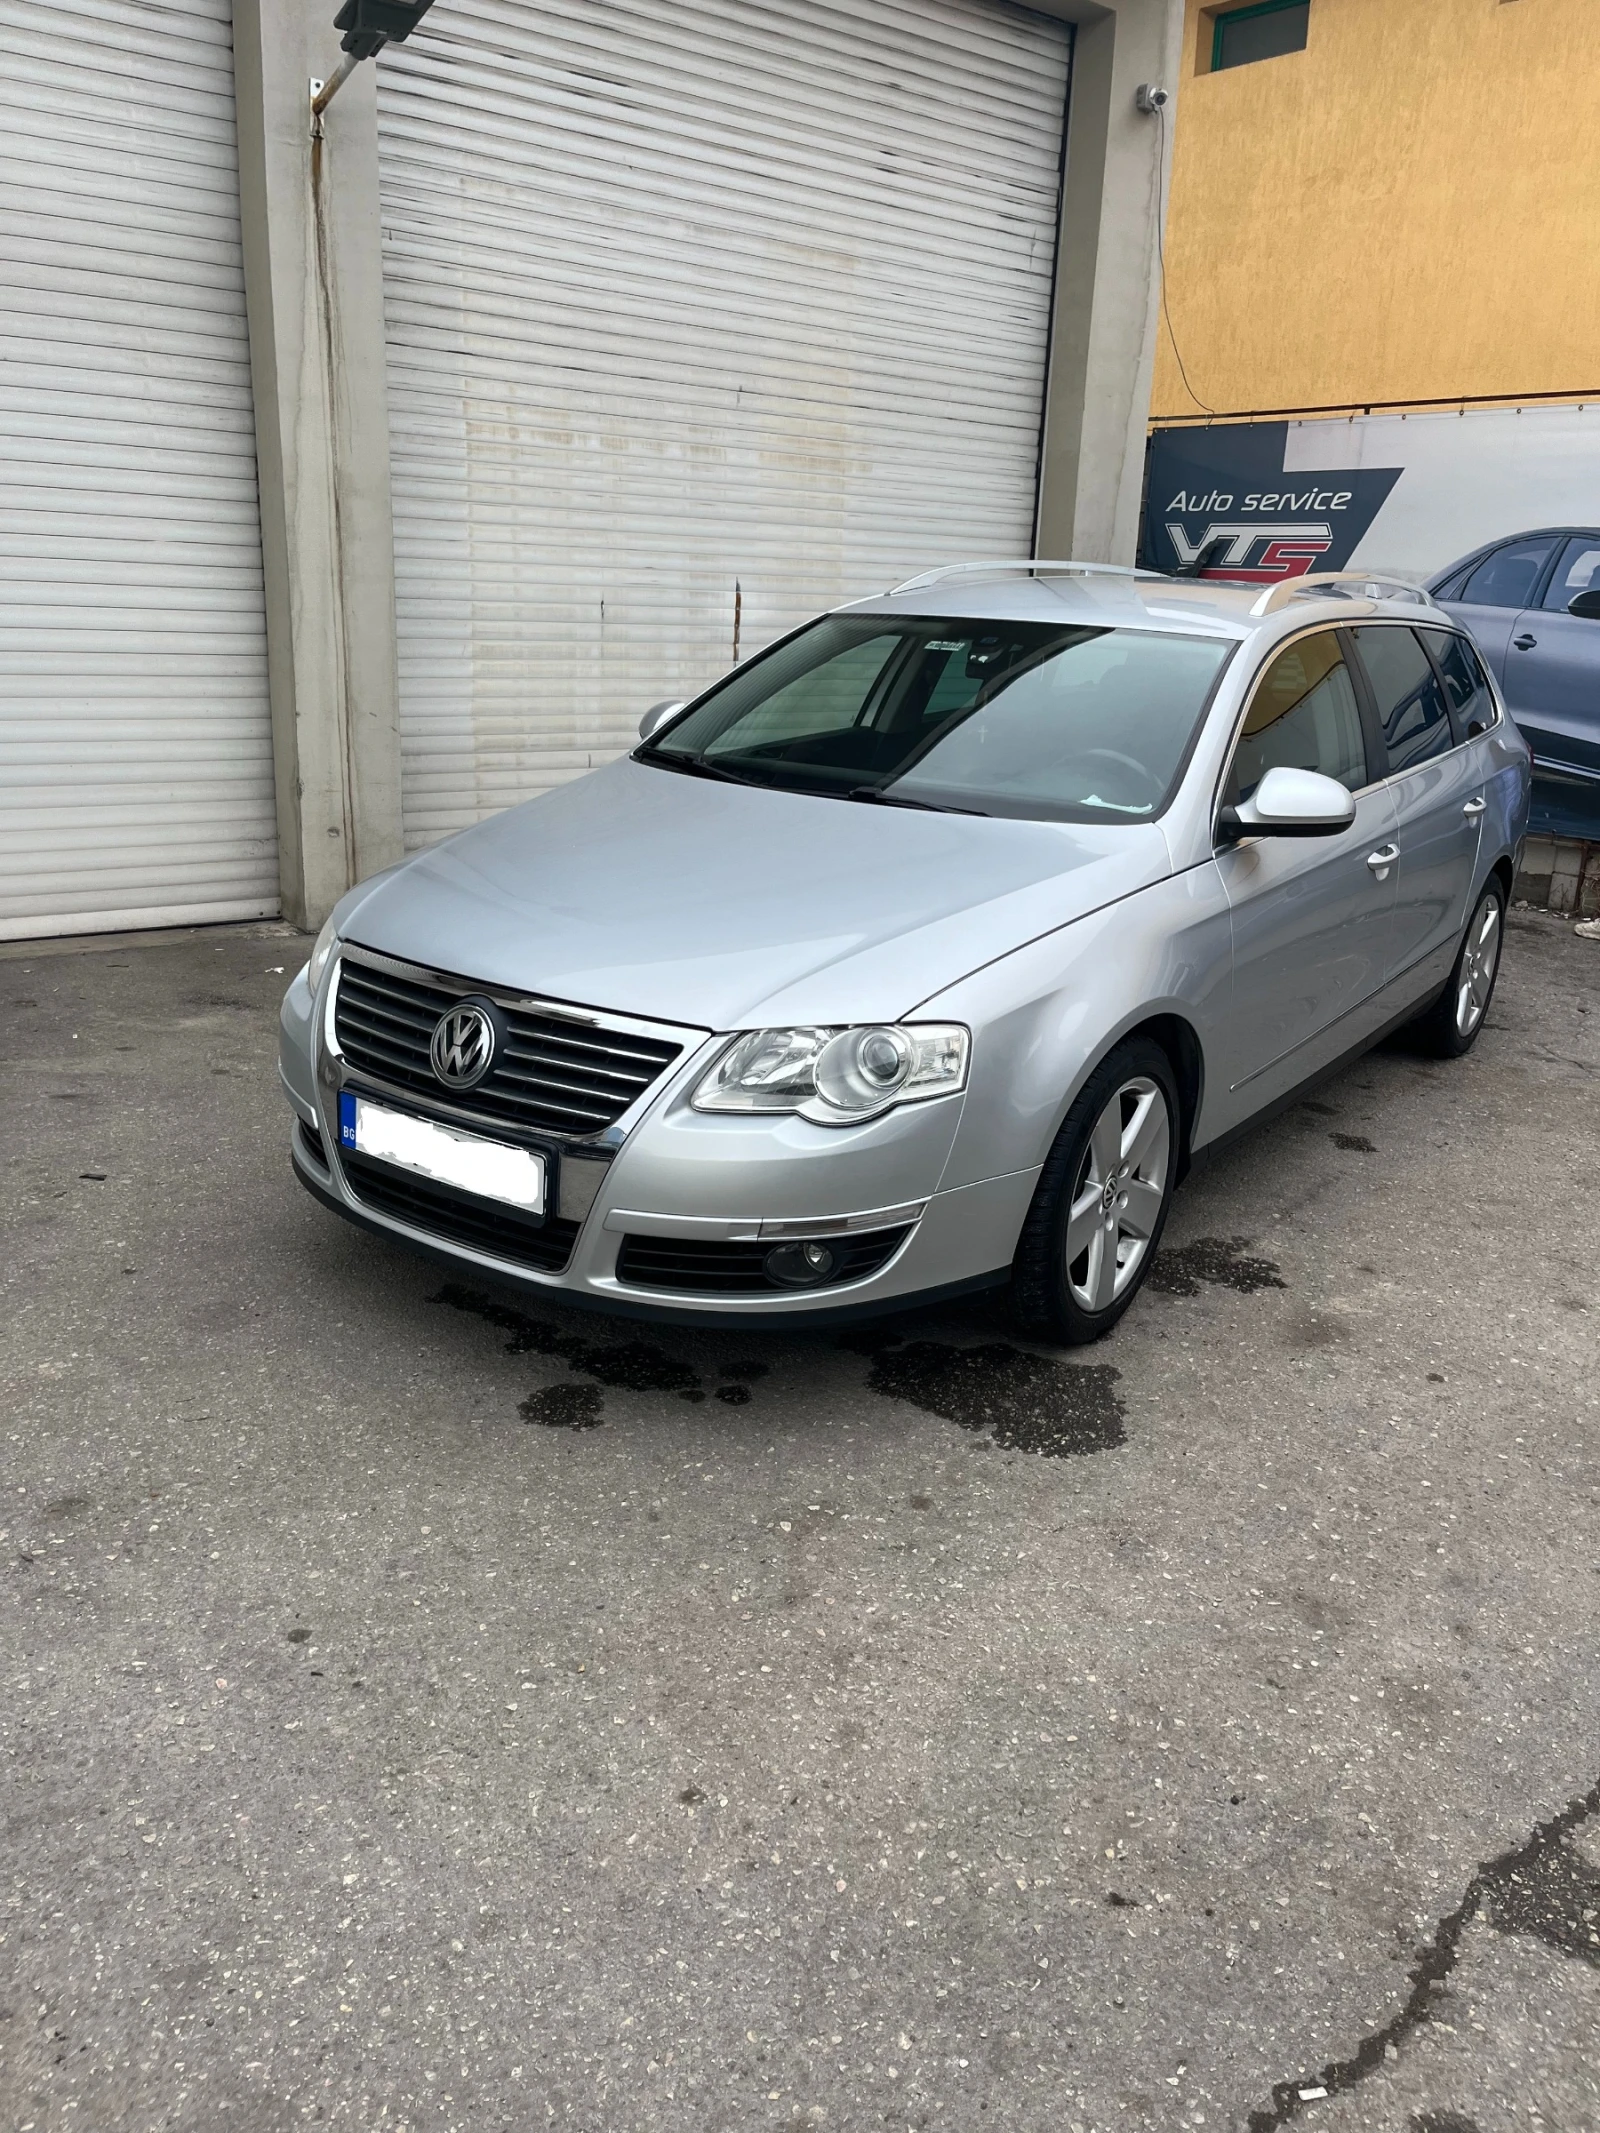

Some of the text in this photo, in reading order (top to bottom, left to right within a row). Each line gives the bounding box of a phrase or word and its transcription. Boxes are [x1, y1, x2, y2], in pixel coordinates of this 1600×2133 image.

[1165, 487, 1352, 512] Auto service
[1165, 522, 1334, 584] VTS
[434, 1008, 491, 1083] VW
[343, 1125, 355, 1140] BG
